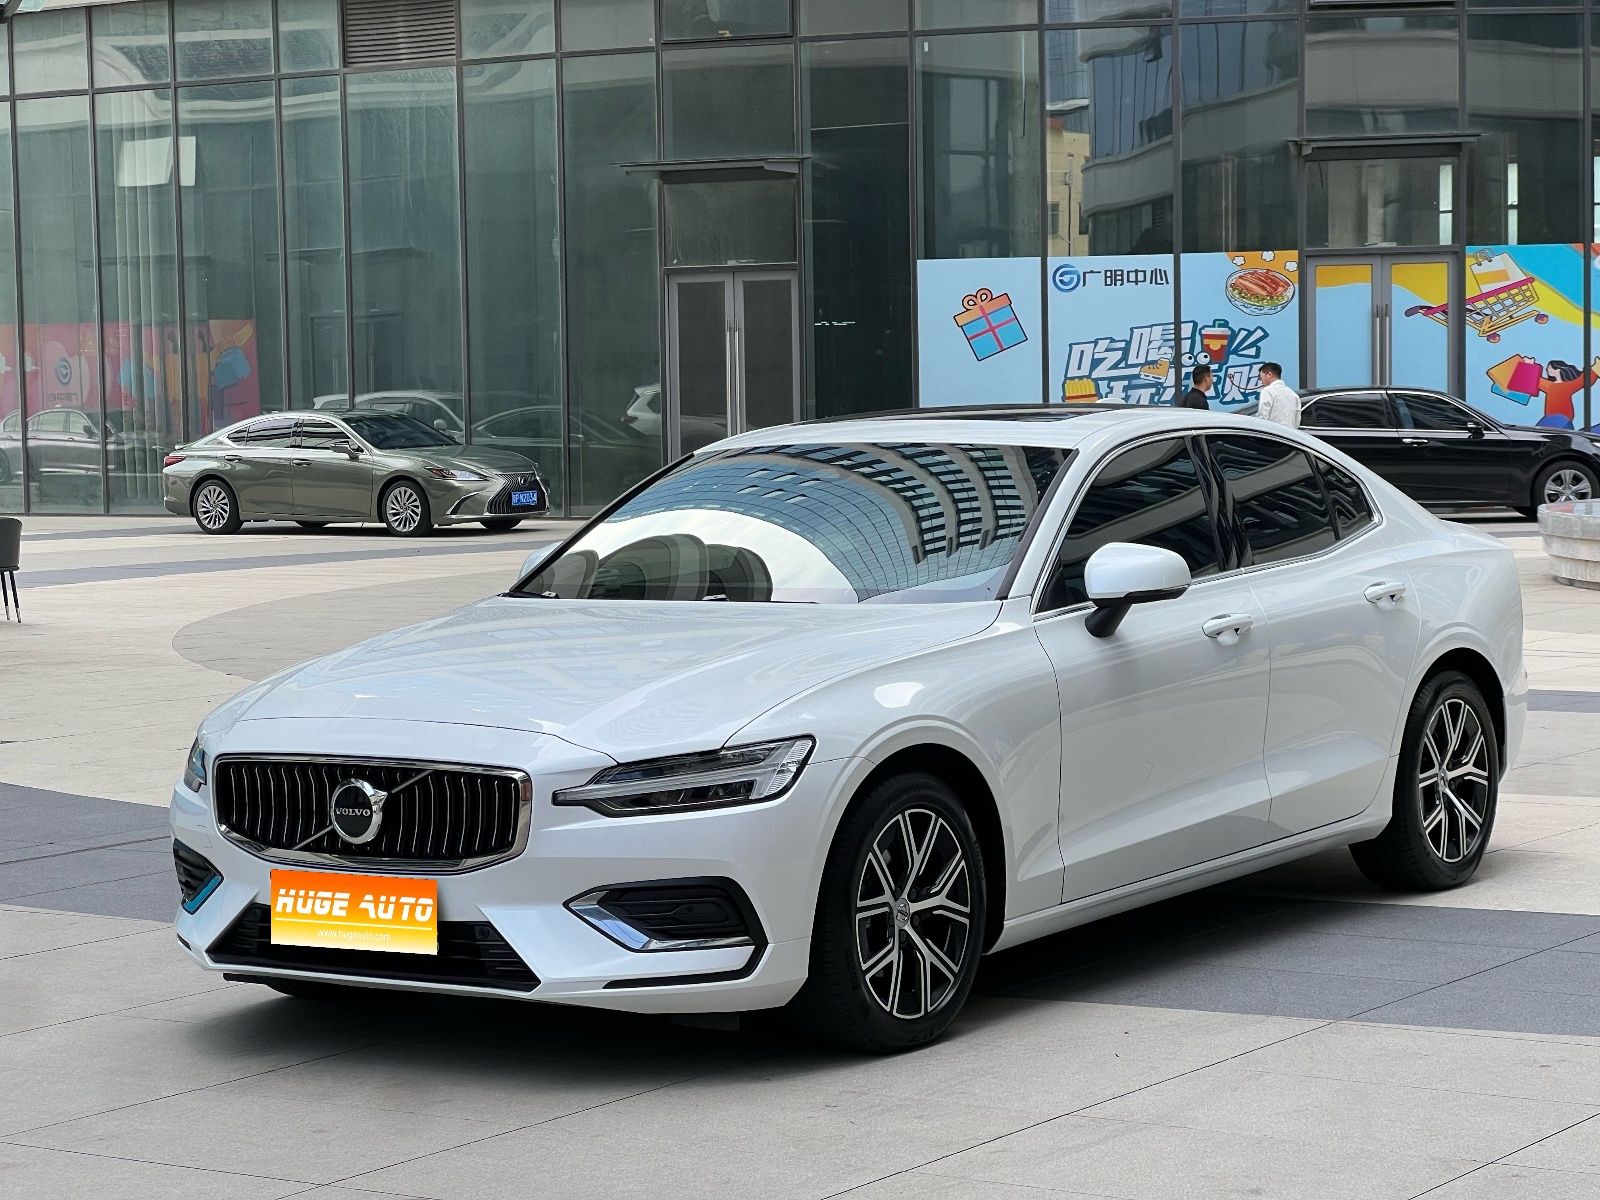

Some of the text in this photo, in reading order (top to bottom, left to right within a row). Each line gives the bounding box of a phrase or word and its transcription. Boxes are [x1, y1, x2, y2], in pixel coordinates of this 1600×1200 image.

[1082, 268, 1169, 287] 广明中心
[336, 807, 370, 817] VOLVO
